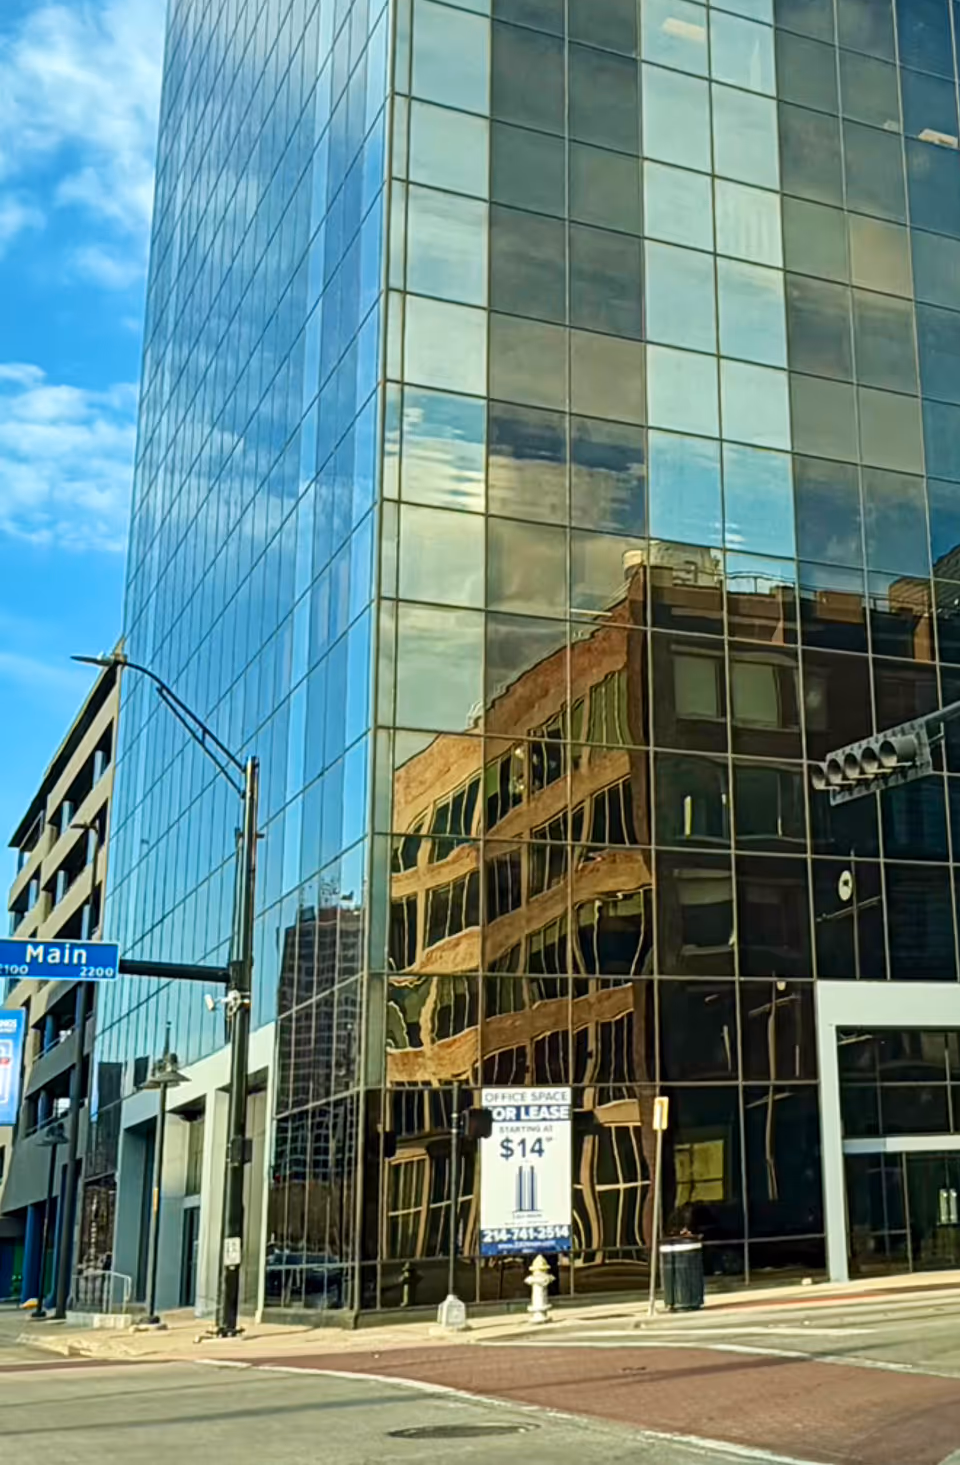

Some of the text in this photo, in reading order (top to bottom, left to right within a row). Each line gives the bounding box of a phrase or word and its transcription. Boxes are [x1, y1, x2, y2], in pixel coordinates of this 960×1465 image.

[25, 943, 87, 964] Main
[80, 966, 114, 977] 2200
[485, 1091, 567, 1102] OFFICE SPACE
[488, 1105, 569, 1121] OR LEASE
[500, 1135, 545, 1161] $14
[483, 1225, 570, 1243] 214-741-2514
